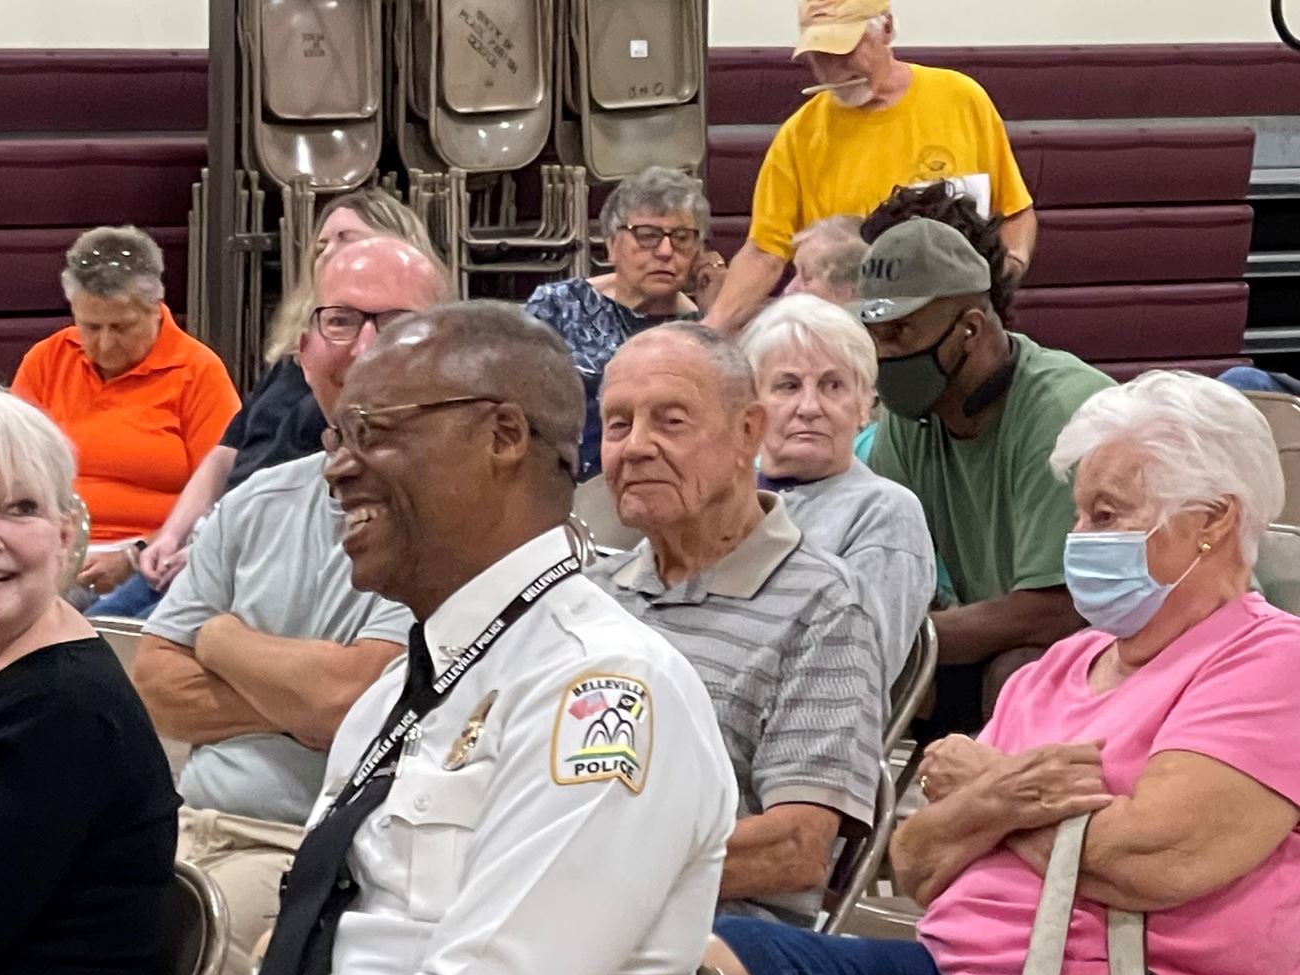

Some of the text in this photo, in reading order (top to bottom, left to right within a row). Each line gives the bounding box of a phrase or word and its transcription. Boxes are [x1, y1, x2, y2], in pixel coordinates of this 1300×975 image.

[521, 563, 567, 602] BELLEVILLE
[433, 618, 505, 694] BELLEVILLE POLICE
[353, 709, 418, 787] BELLEVILLE POLICE
[574, 760, 634, 780] POLICE
